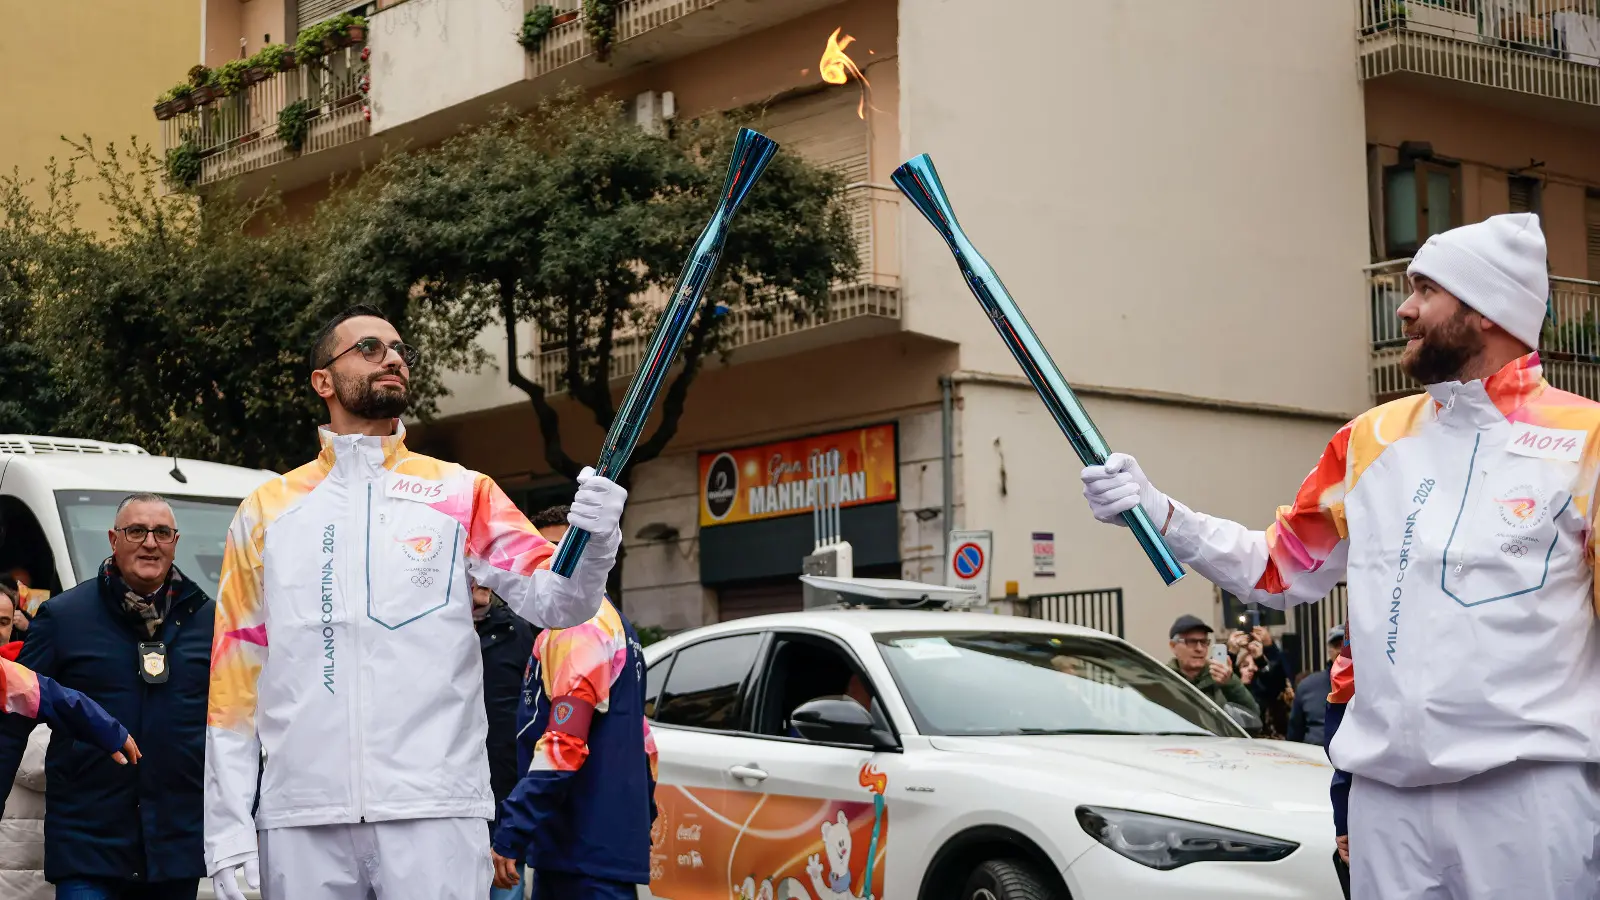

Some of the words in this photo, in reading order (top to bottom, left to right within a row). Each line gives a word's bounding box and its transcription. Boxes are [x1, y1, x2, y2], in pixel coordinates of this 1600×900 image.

[322, 523, 335, 554] 2026
[1386, 586, 1402, 666] MILANO
[1396, 508, 1422, 583] CORTINA
[1412, 477, 1436, 505] 2026
[321, 557, 334, 624] CORTINA
[323, 626, 335, 695] MILANO
[677, 852, 692, 866] eni
